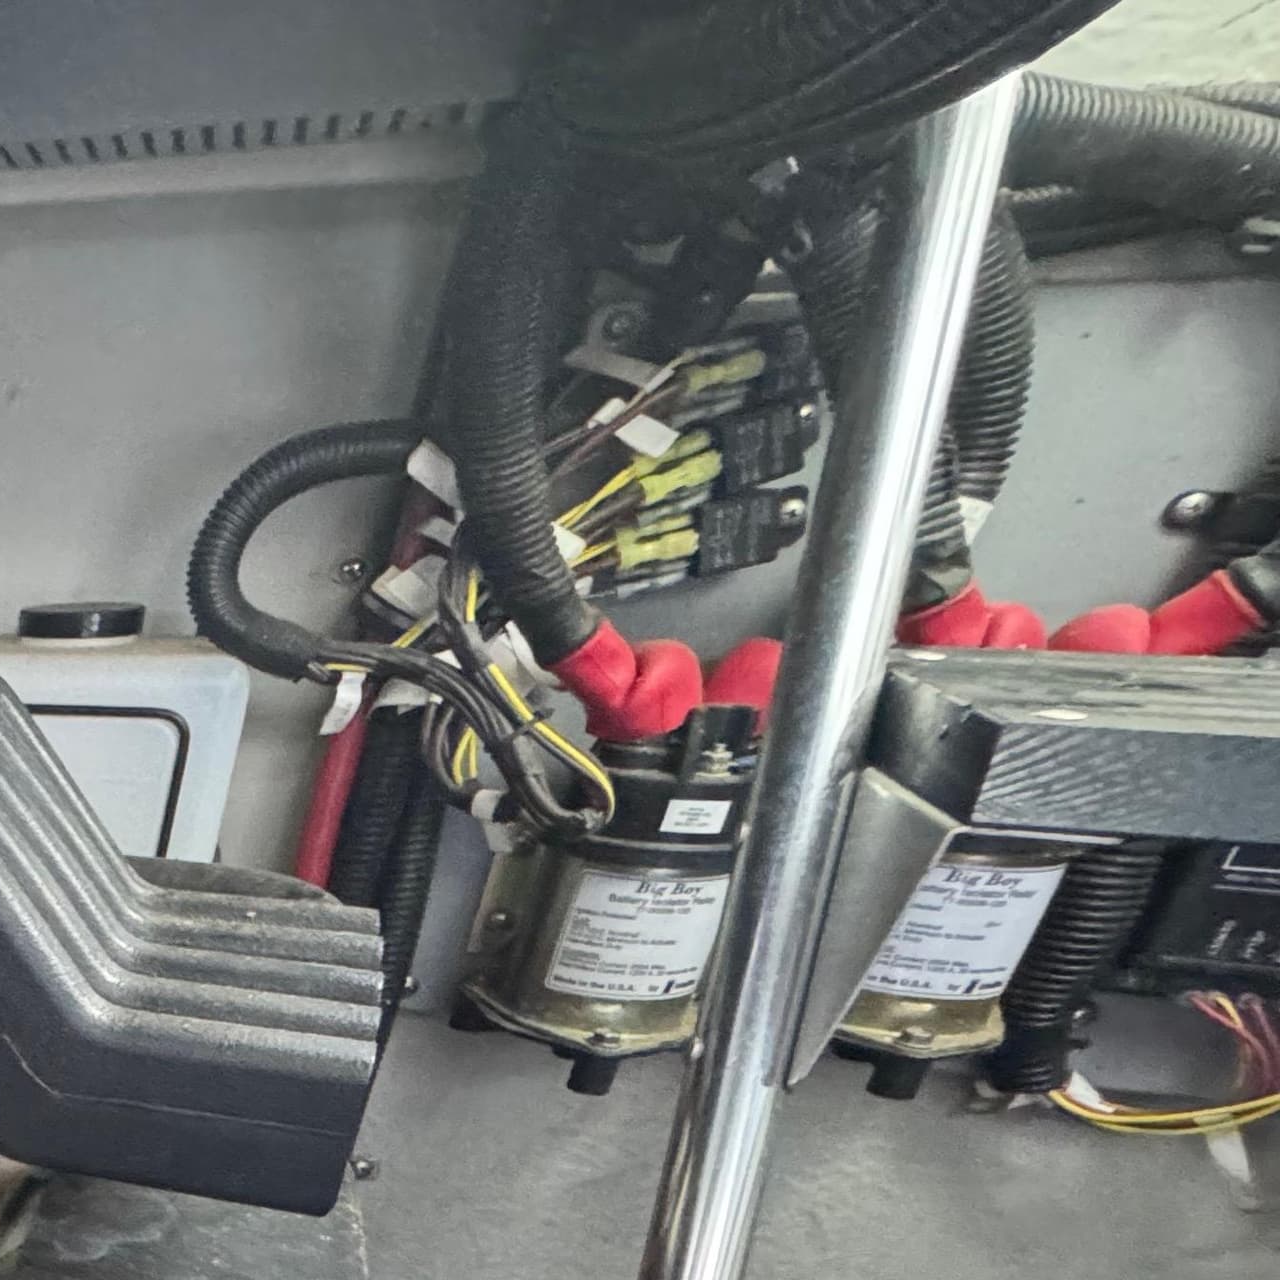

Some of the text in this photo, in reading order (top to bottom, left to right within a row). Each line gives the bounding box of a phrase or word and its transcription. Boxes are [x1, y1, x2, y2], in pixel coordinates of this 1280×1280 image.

[943, 869, 1023, 889] Big Boy
[635, 882, 704, 898] Big Boy
